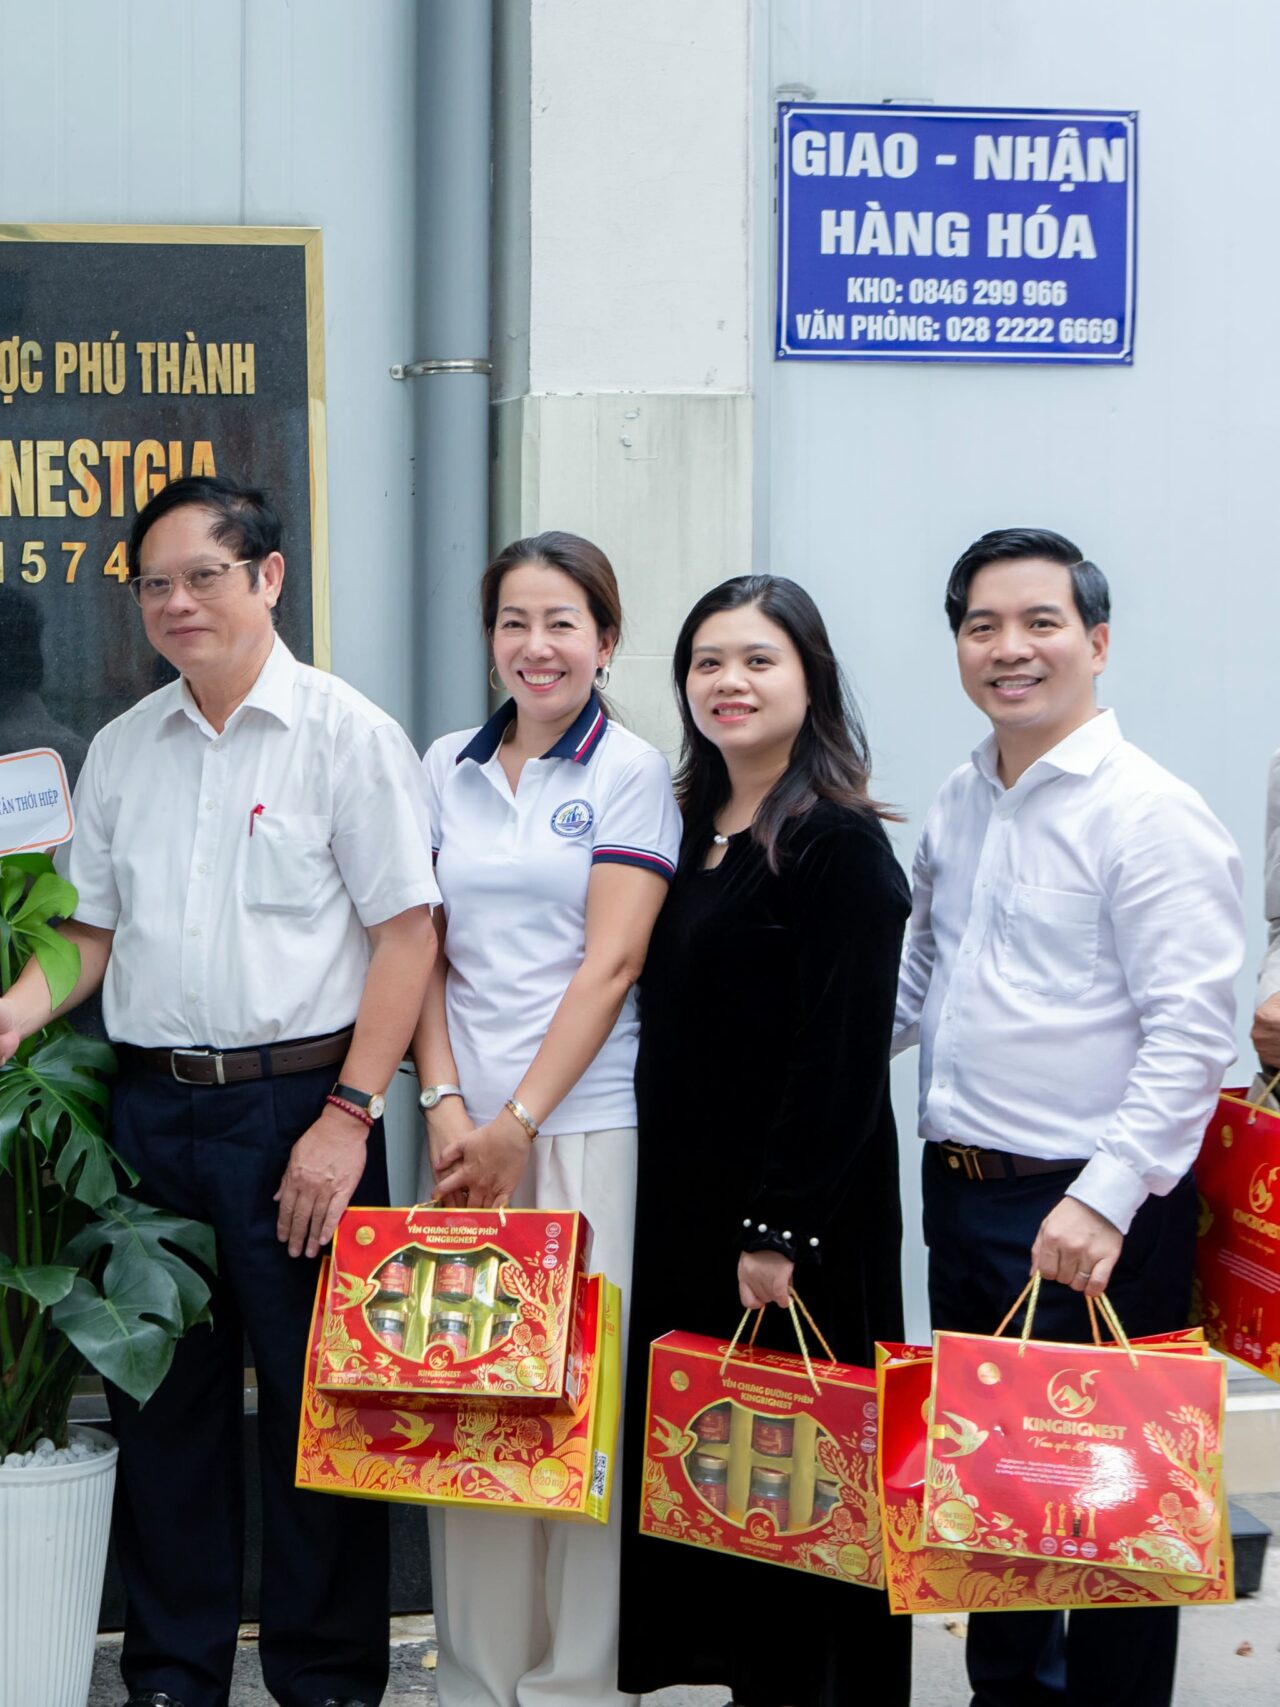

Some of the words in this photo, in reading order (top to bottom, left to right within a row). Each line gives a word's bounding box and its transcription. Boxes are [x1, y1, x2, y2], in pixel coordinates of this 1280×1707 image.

[791, 130, 918, 178] GIAO
[935, 154, 957, 166] -
[973, 127, 1126, 192] NHẬN
[820, 200, 970, 258] HÀNG
[987, 204, 1097, 259] HÓA
[847, 277, 903, 304] KHO:
[908, 278, 968, 305] 0846
[972, 279, 1018, 306] 299
[1022, 280, 1067, 307] 966
[795, 308, 845, 340] VĂN
[851, 309, 940, 342] PHÒNG:
[946, 316, 991, 343] 028
[995, 317, 1054, 343] 2222
[1058, 317, 1117, 344] 6669
[54, 331, 126, 395] PHÚ
[136, 331, 255, 395] THÀNH
[39, 789, 59, 806] HIỆP
[1022, 1416, 1127, 1440] KINGBIGNEST
[534, 1475, 551, 1486] 920
